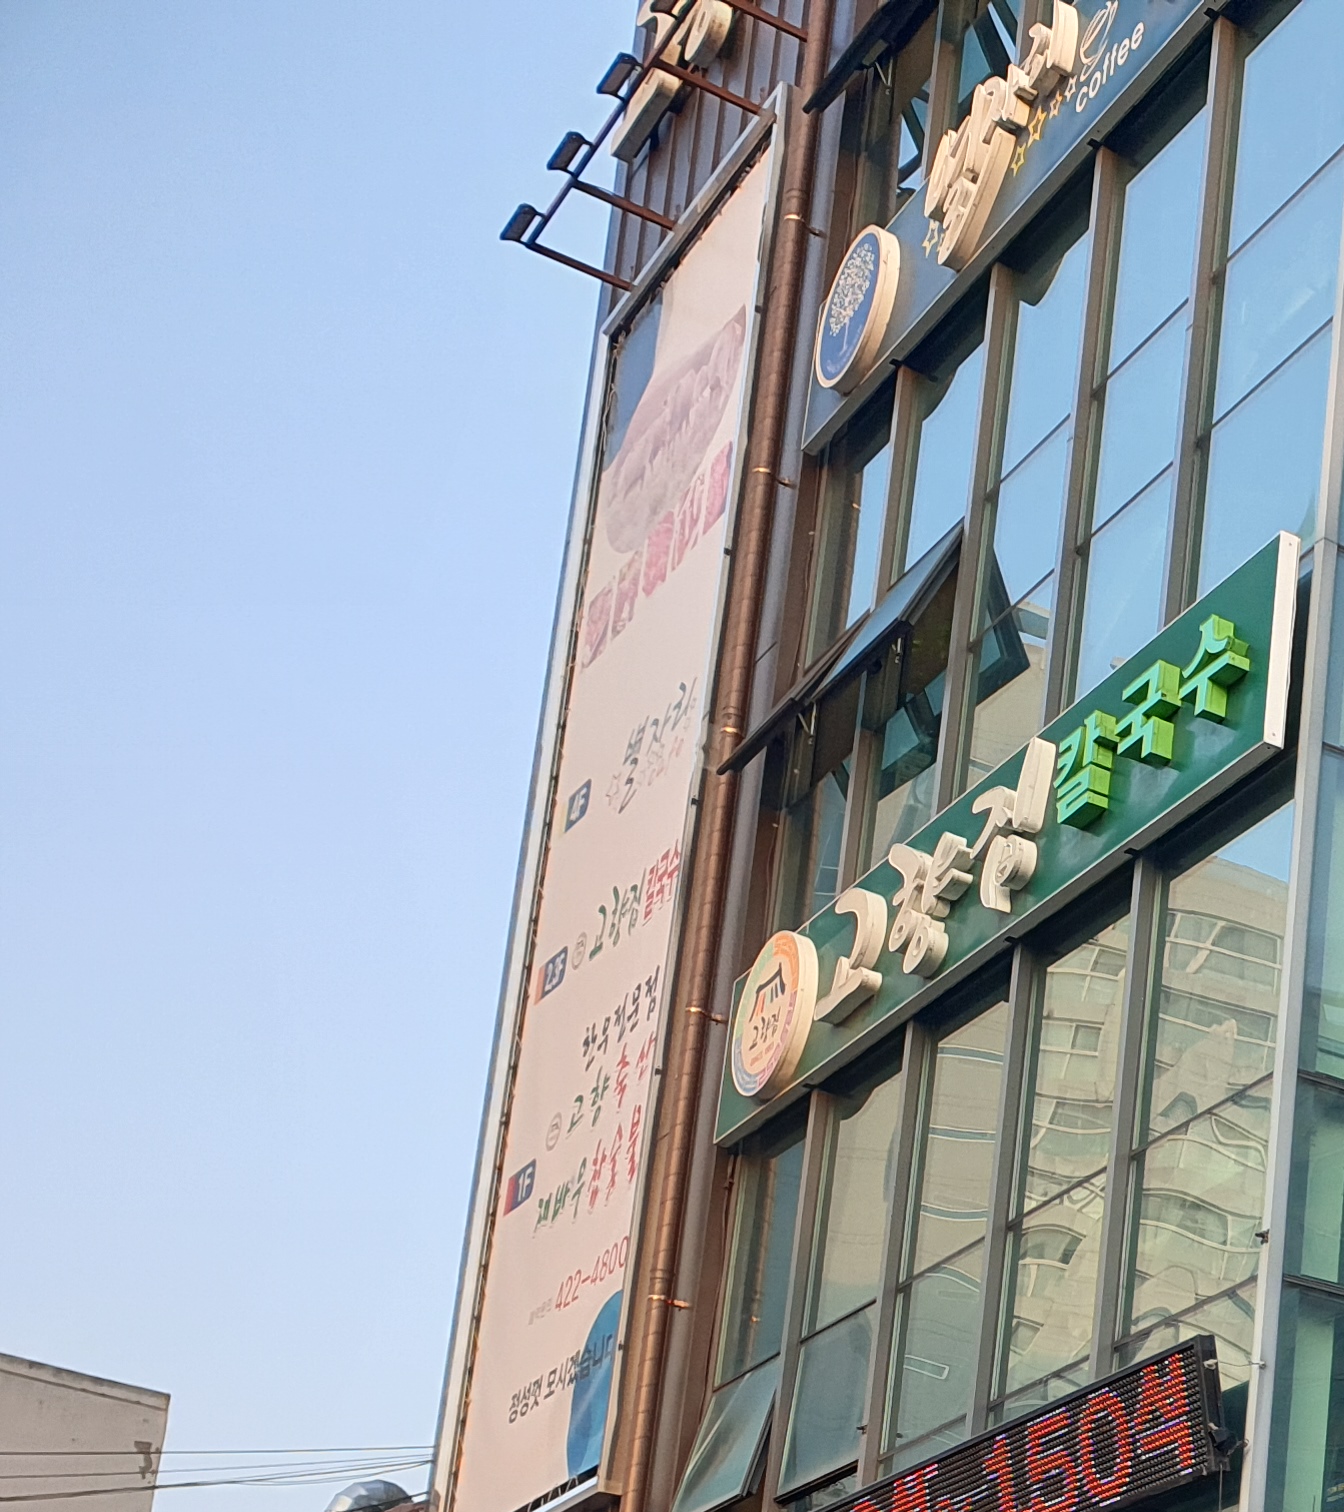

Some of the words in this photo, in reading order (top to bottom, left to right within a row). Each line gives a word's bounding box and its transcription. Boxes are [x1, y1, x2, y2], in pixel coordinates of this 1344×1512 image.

[1075, 21, 1146, 113] coffee
[815, 737, 1056, 1026] 고향집
[1053, 614, 1250, 827] 칼국수
[589, 867, 646, 961] 고향집
[582, 965, 660, 1071] 한우전문점
[749, 1006, 781, 1051] 고향집
[567, 1031, 657, 1134] 고향축산
[517, 1166, 534, 1203] 1F
[533, 1157, 587, 1234] 재바우
[554, 1235, 629, 1311] 422-4800
[508, 1375, 542, 1425] 정성껏
